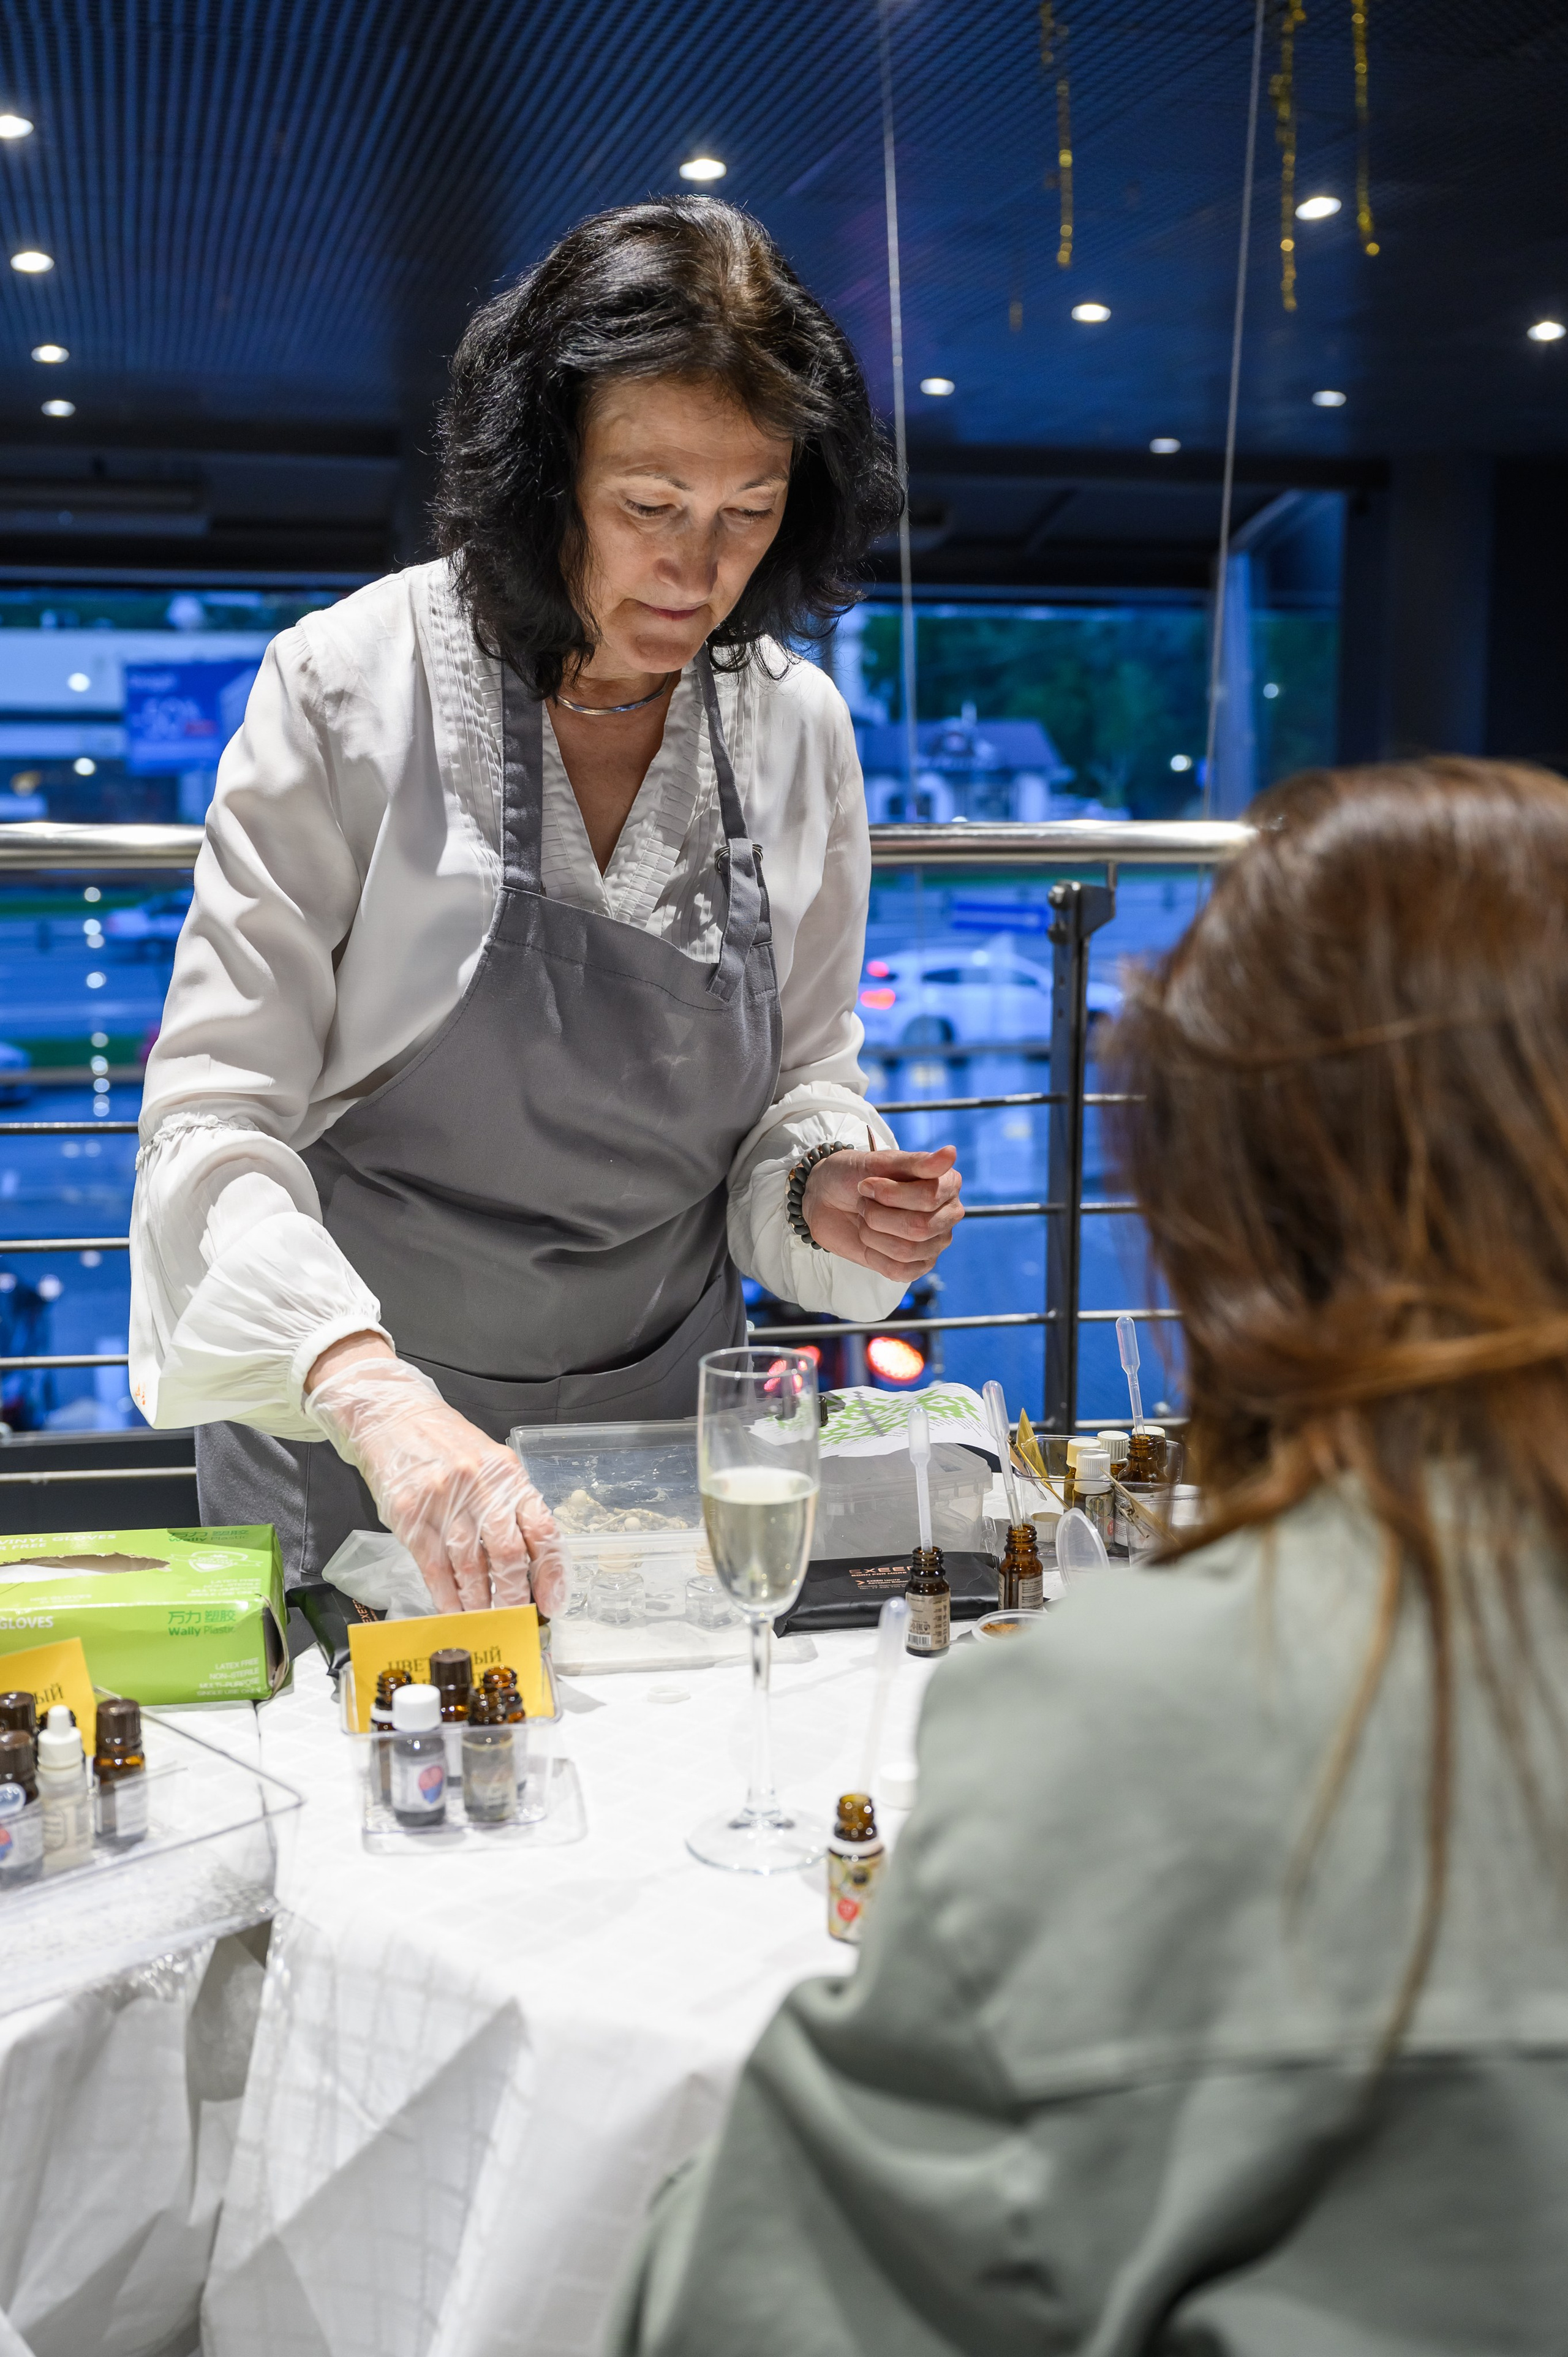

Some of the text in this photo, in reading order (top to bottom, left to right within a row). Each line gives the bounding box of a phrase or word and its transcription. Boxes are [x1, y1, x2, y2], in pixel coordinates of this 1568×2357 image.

[353, 1600, 372, 1622] EXEE
[0, 1615, 54, 1630] GLOVES
[168, 1625, 236, 1637] Wally Plastic
[214, 1657, 260, 1670] LATEX FREE
[209, 1667, 260, 1680] NON-STERILE
